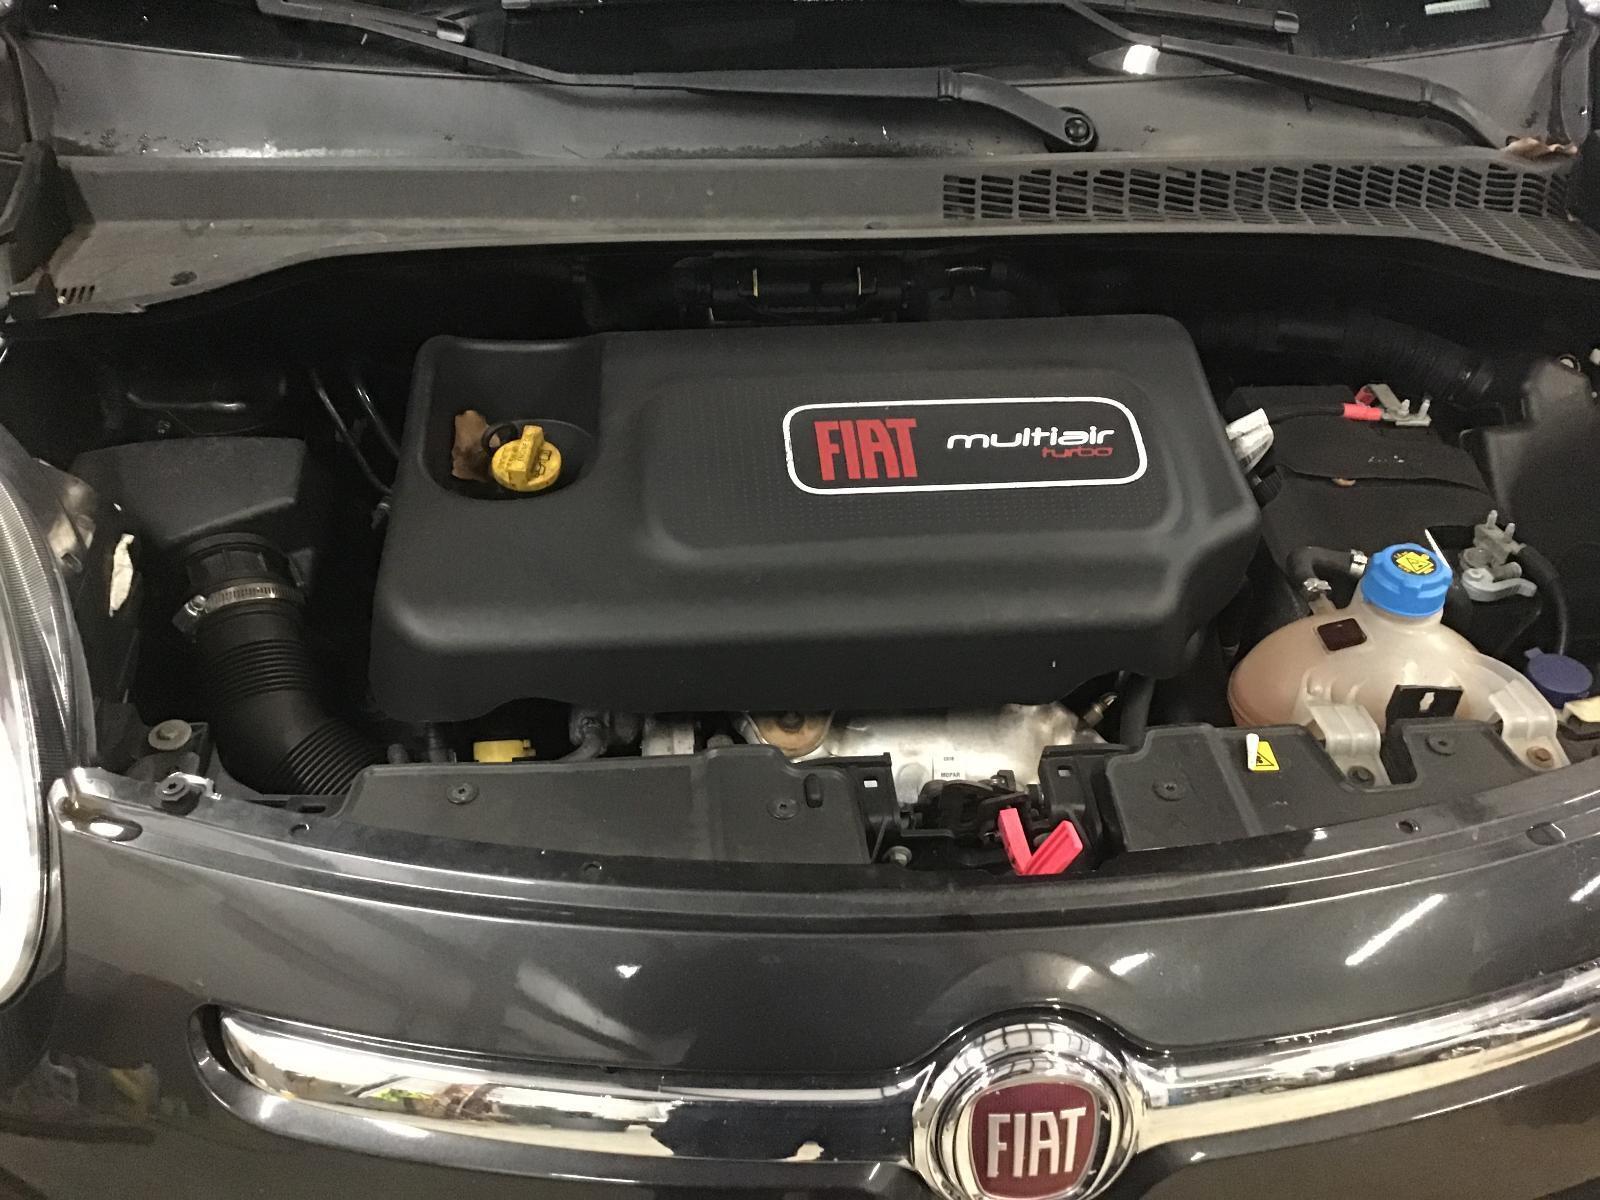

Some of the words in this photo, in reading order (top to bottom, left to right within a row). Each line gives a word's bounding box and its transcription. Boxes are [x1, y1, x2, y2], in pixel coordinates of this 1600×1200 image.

[814, 418, 918, 481] FIAT
[946, 426, 1115, 450] multiair
[1041, 446, 1114, 459] turbo
[986, 1107, 1087, 1178] FIAT
